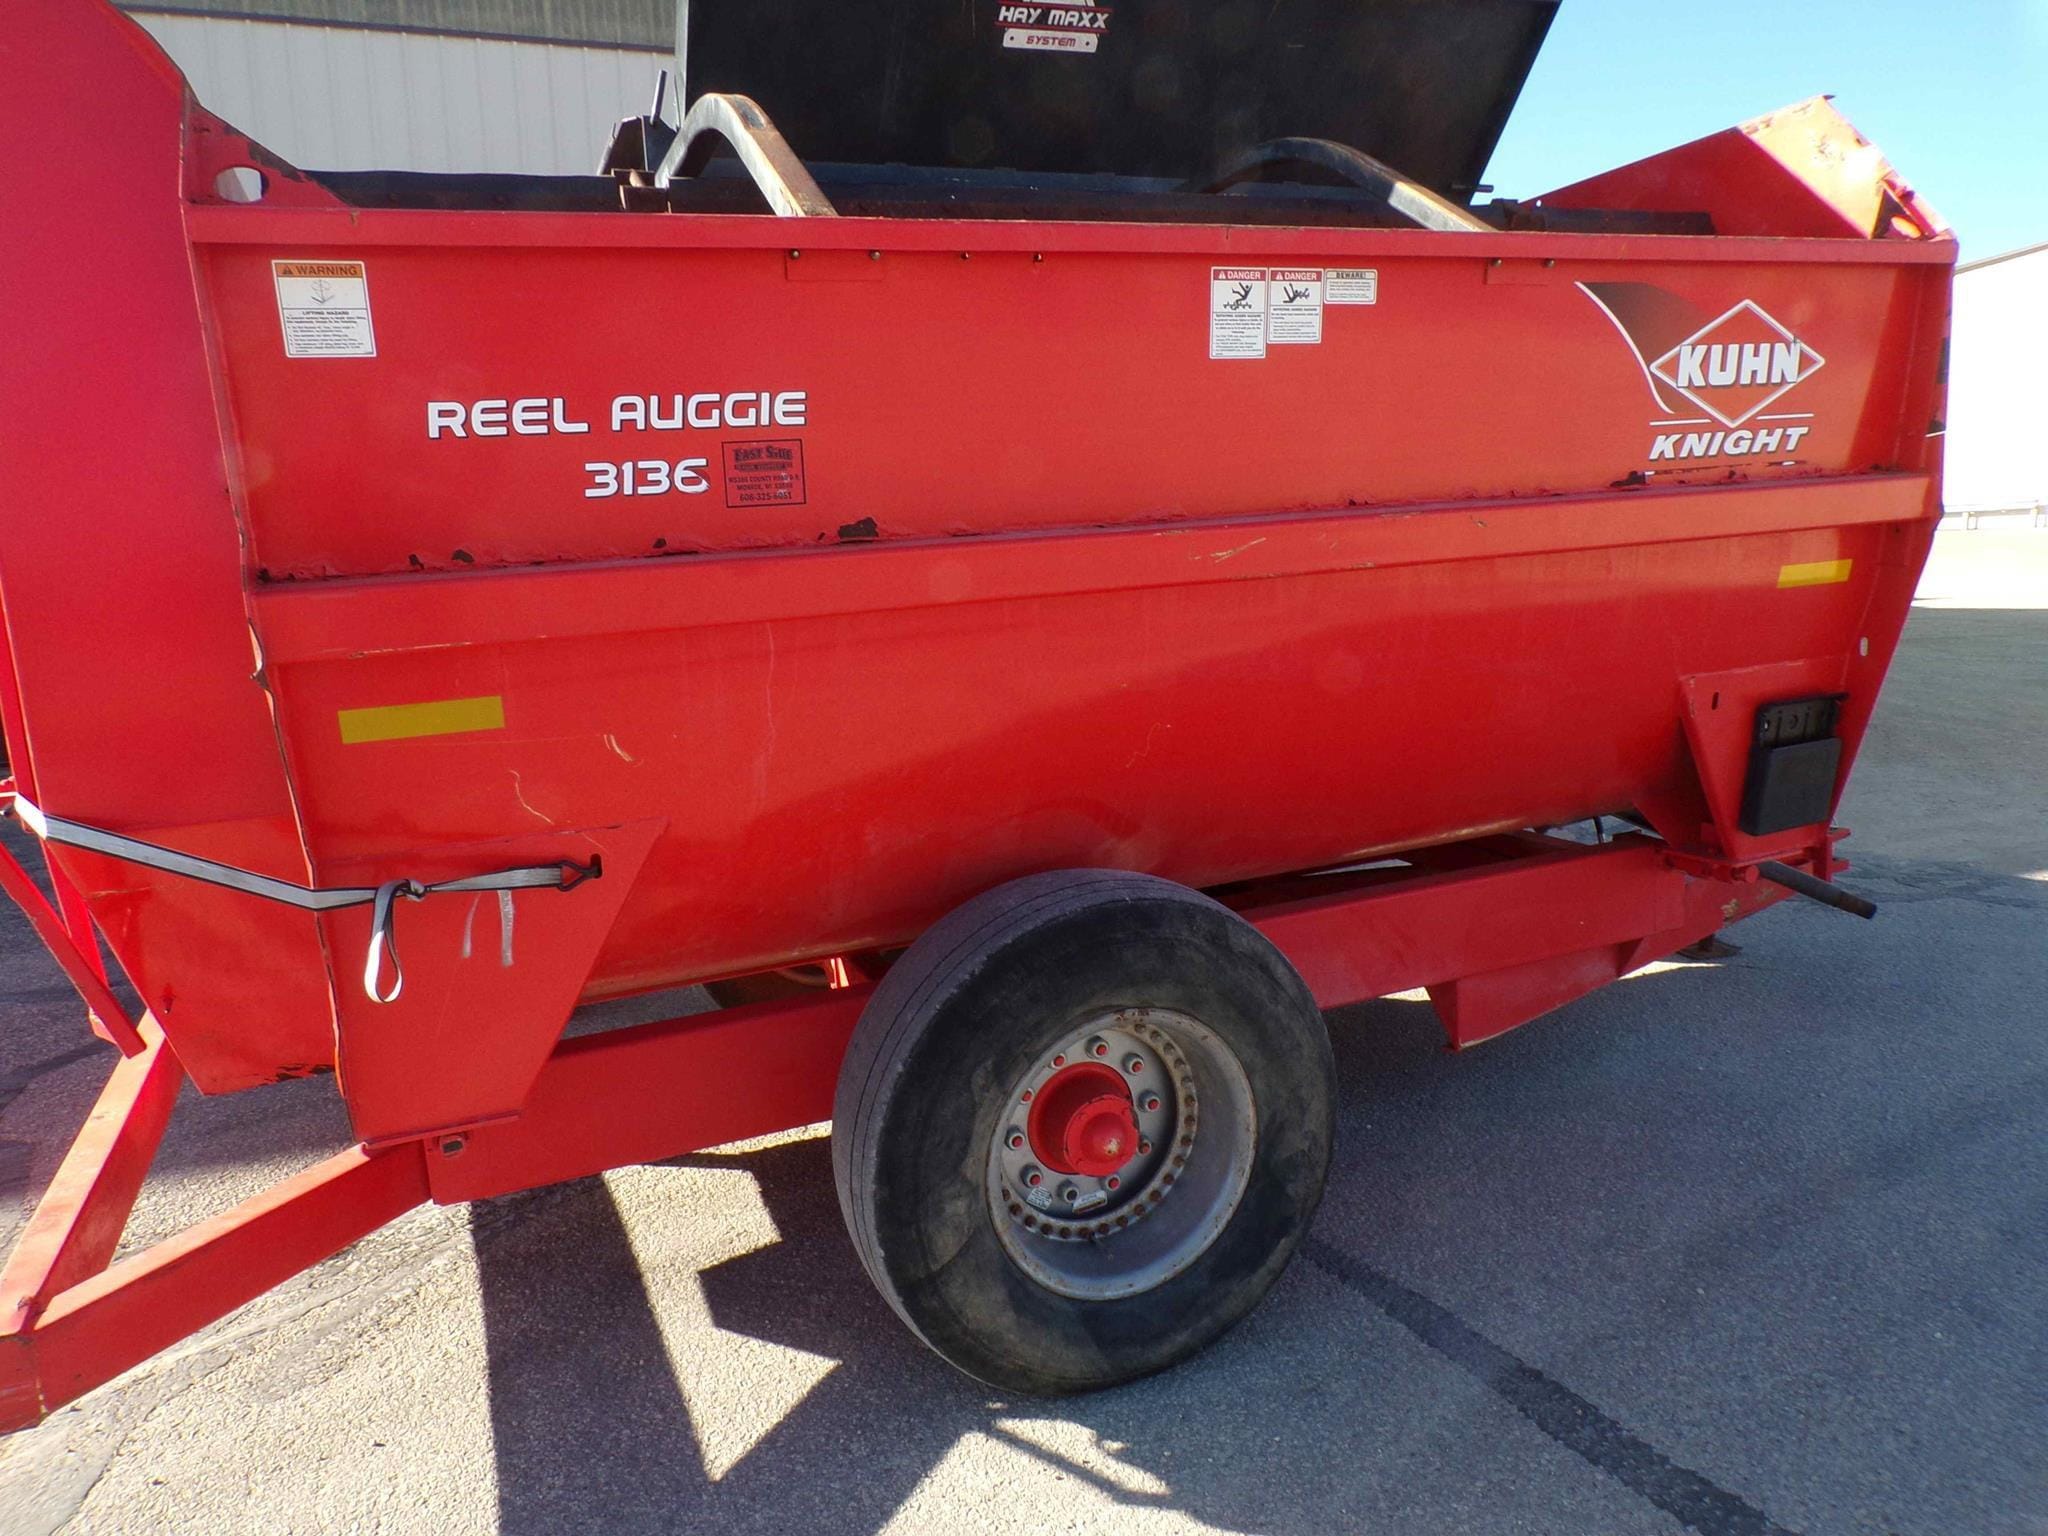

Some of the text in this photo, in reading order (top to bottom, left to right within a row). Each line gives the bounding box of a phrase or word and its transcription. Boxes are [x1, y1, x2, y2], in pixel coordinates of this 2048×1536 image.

[998, 6, 1109, 29] HAY MAXX
[1026, 35, 1077, 48] SYSTEM
[296, 265, 358, 276] WARNING
[1227, 269, 1261, 280] DANGER
[1284, 270, 1317, 281] DANGER
[1677, 342, 1802, 387] KUHN
[427, 391, 807, 439] REEL AUGGIE
[1649, 427, 1810, 461] KNIGHT
[584, 458, 711, 499] 3136
